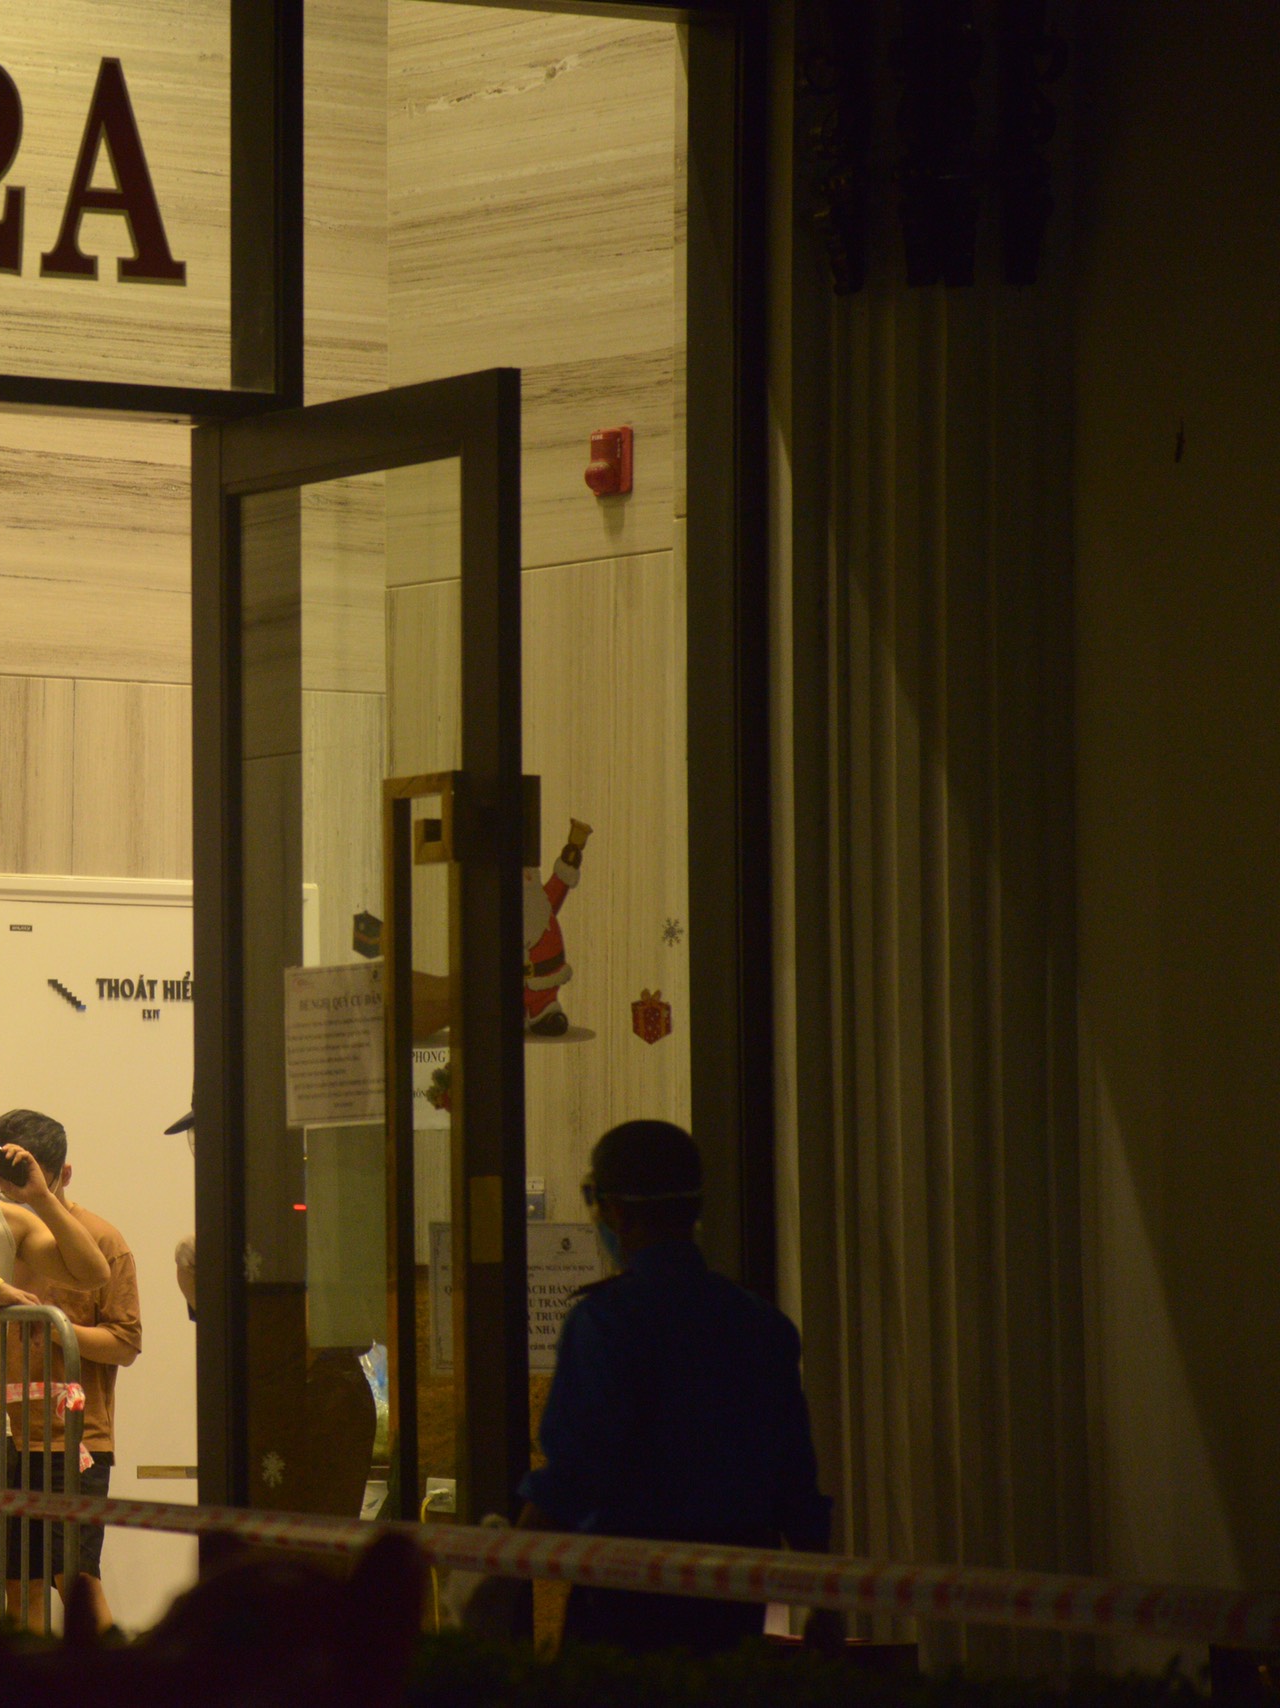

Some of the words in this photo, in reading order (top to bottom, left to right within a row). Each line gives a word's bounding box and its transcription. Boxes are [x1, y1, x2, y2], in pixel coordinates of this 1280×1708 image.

[591, 433, 603, 441] FIRE
[96, 974, 158, 999] THOÁT
[162, 971, 194, 1000] HIỂ
[142, 1009, 161, 1019] EXIT
